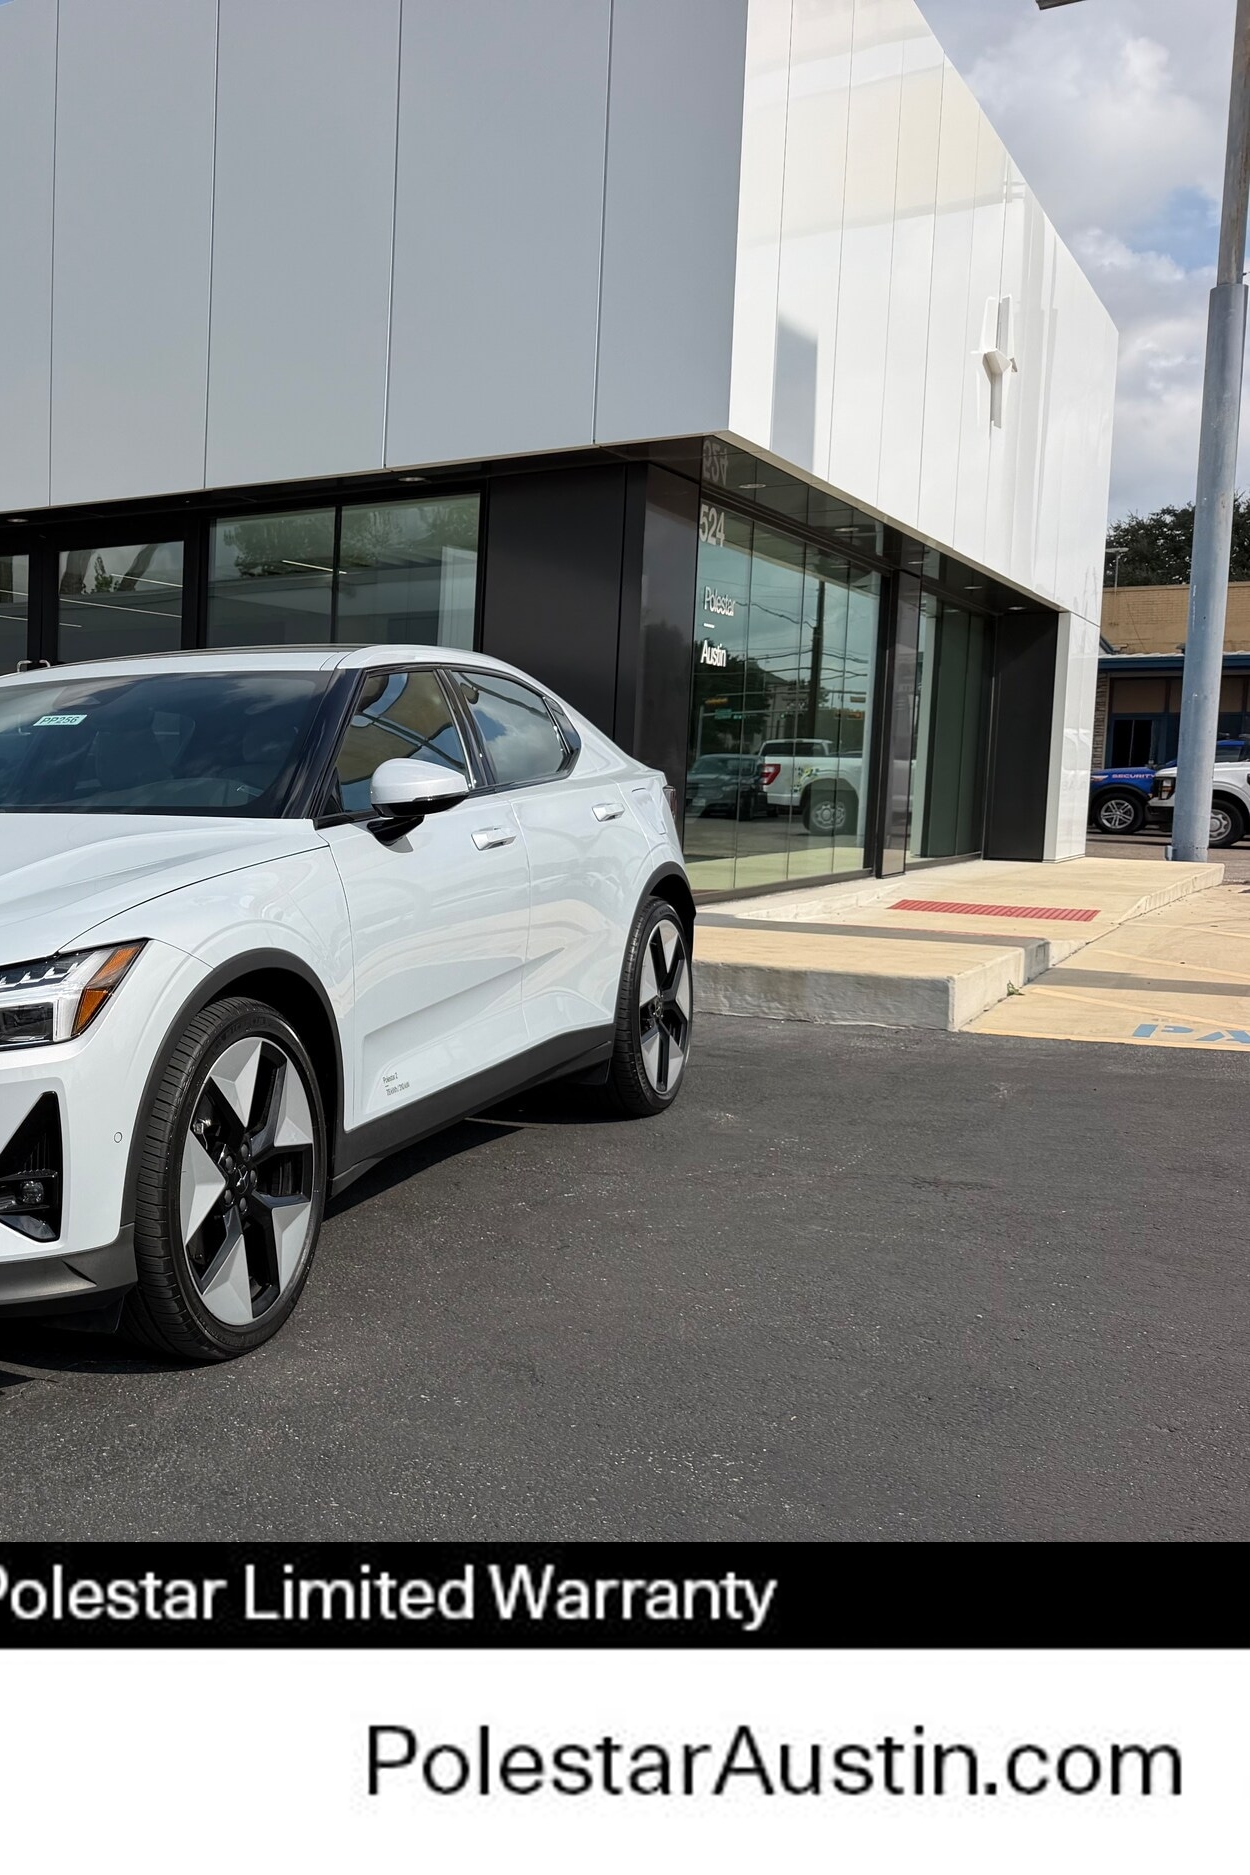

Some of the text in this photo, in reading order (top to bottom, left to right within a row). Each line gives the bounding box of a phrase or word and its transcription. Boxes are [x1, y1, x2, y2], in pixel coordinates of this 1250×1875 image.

[700, 503, 726, 548] 524
[704, 586, 736, 616] Polestar
[700, 639, 727, 668] Austin
[39, 716, 80, 725] PP256
